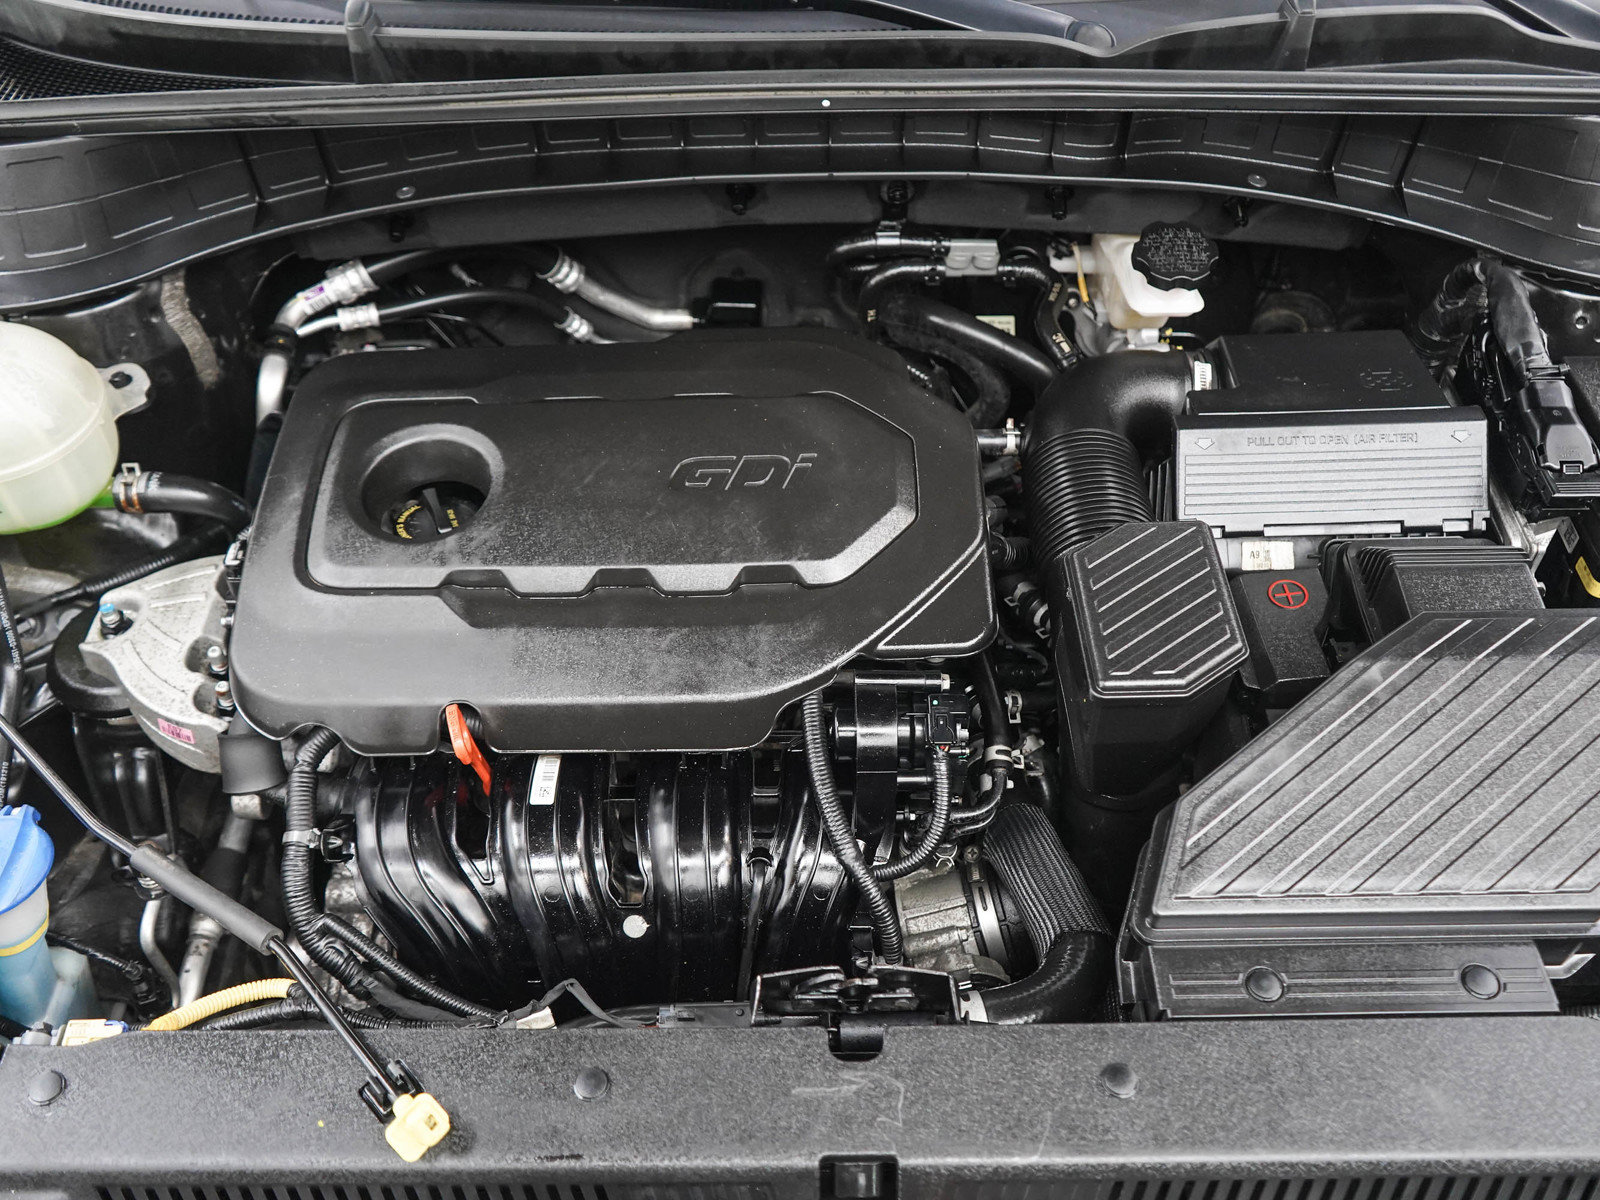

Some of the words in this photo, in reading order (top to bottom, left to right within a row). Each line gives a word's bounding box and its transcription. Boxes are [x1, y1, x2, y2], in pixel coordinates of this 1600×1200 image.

[1247, 436, 1275, 447] PULL
[1277, 436, 1300, 446] OUT
[1302, 435, 1317, 445] TO
[1319, 434, 1349, 445] OPEN
[669, 452, 818, 491] GDi
